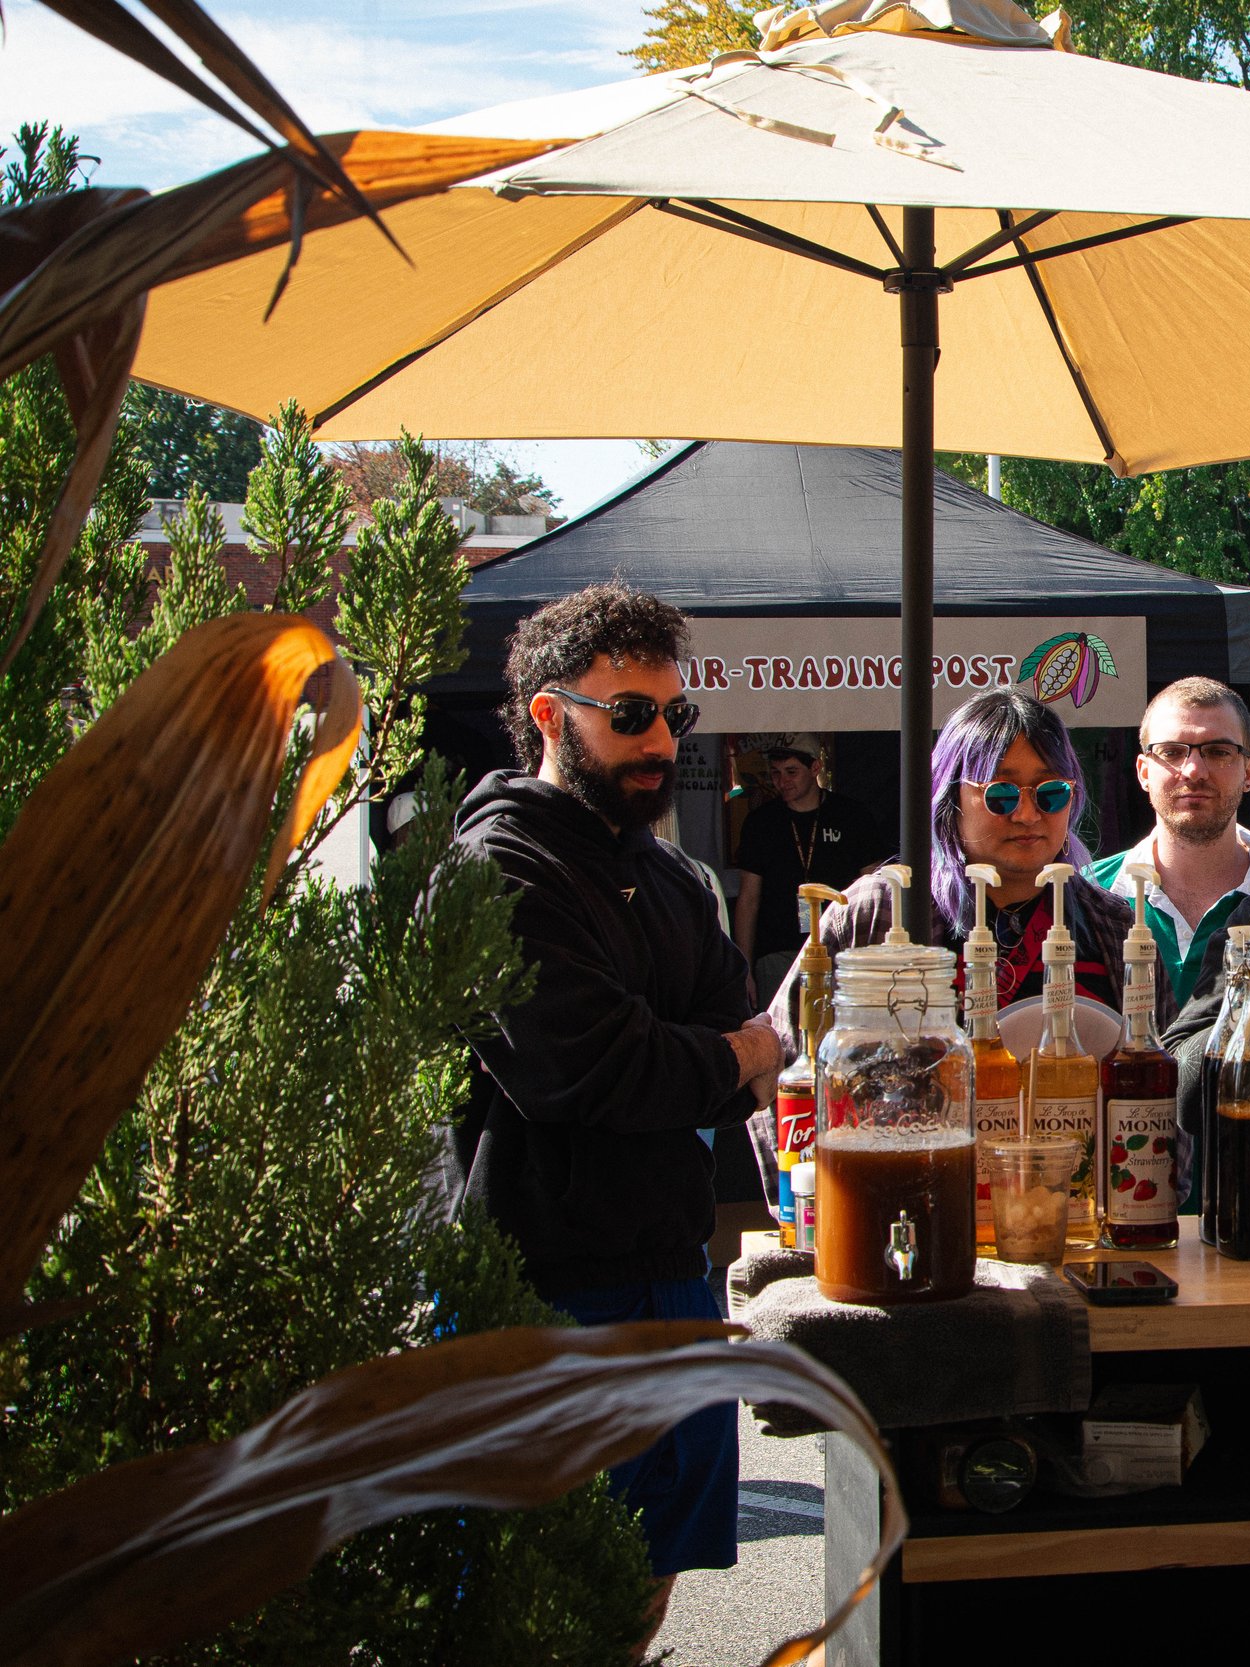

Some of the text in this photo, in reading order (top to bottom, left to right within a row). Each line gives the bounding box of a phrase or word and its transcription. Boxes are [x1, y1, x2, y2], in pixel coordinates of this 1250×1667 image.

[932, 653, 1016, 689] POST
[976, 1118, 1019, 1132] ONIN
[1033, 1117, 1093, 1131] MONIN
[1118, 1119, 1176, 1132] MONIN
[781, 1111, 815, 1154] Tor
